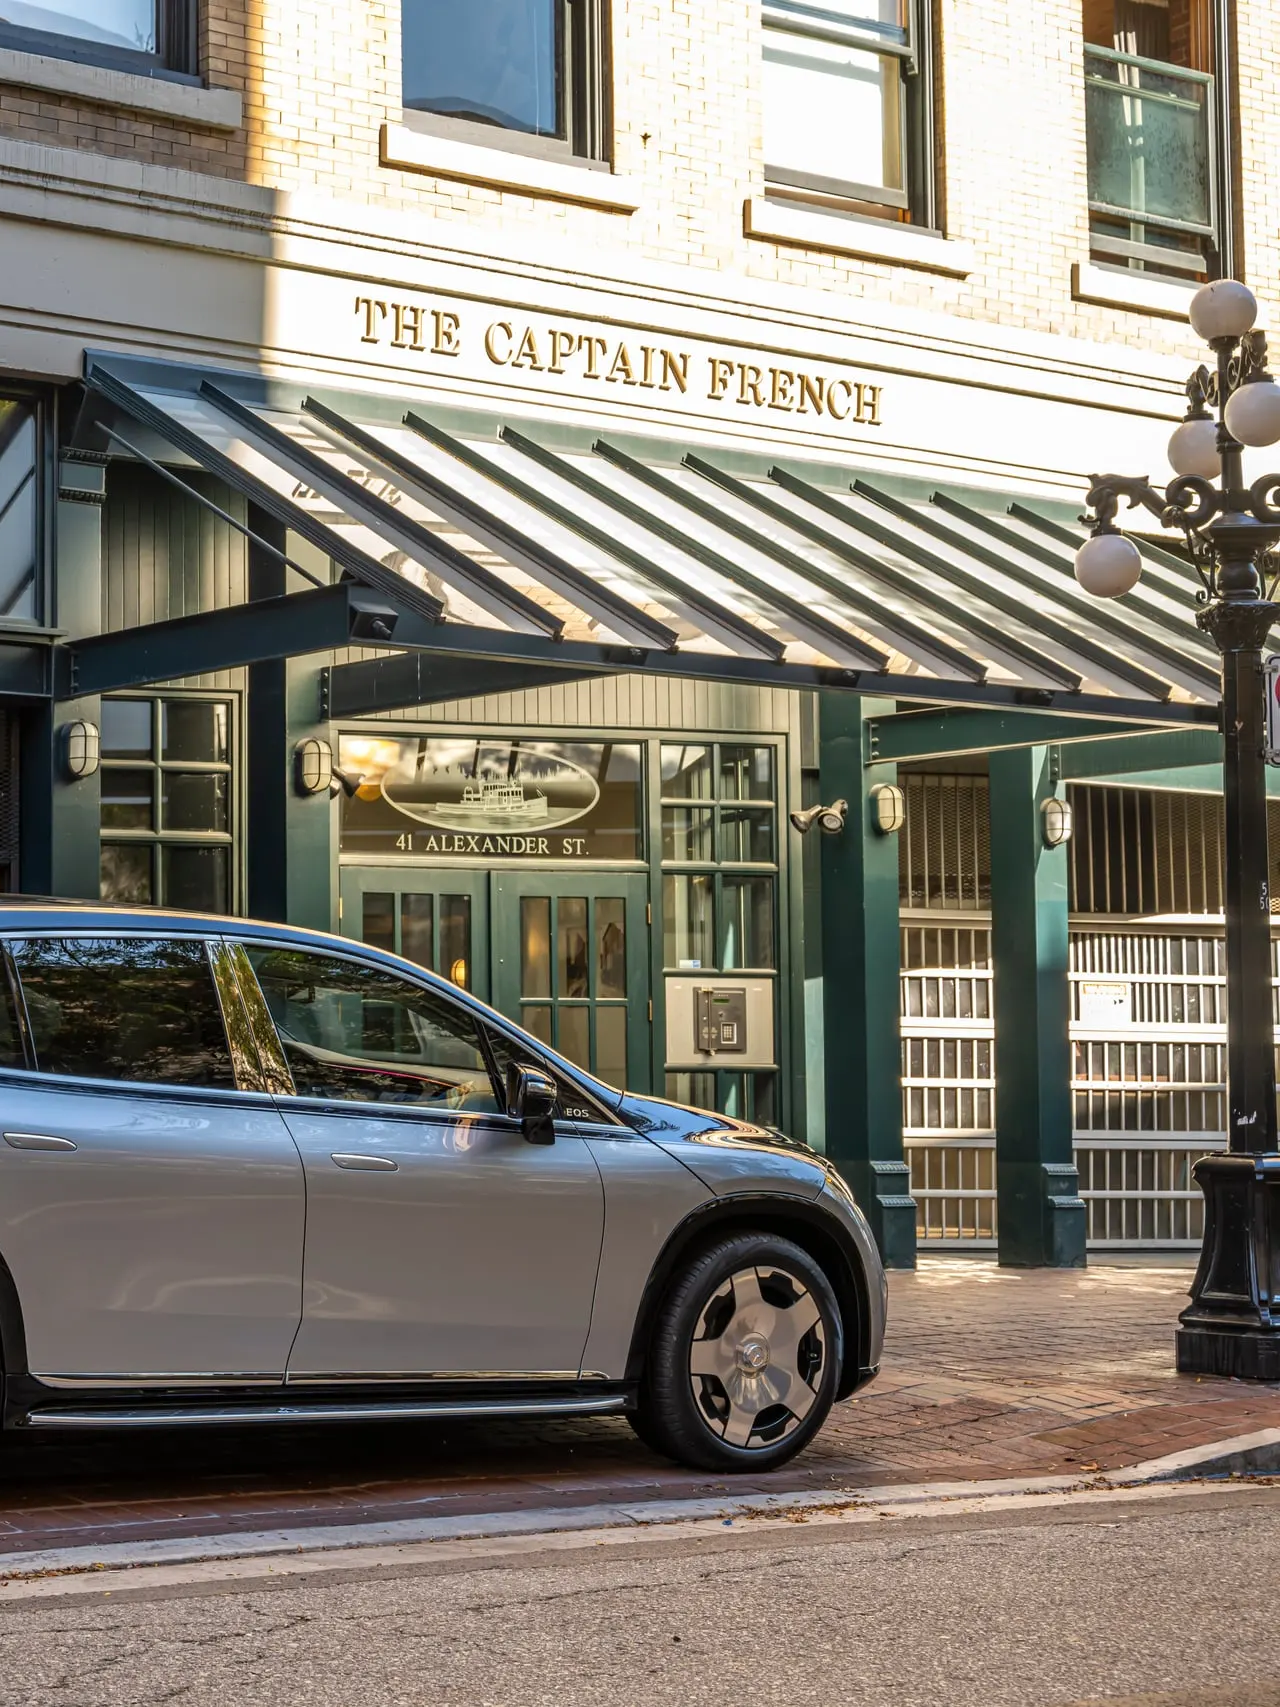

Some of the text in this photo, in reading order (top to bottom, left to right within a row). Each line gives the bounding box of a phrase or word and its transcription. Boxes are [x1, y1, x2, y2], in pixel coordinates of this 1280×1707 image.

[354, 297, 883, 426] THE CAPTAIN FRENCH
[396, 834, 590, 856] 41 ALEXANDER ST.
[566, 1107, 589, 1118] EQS
